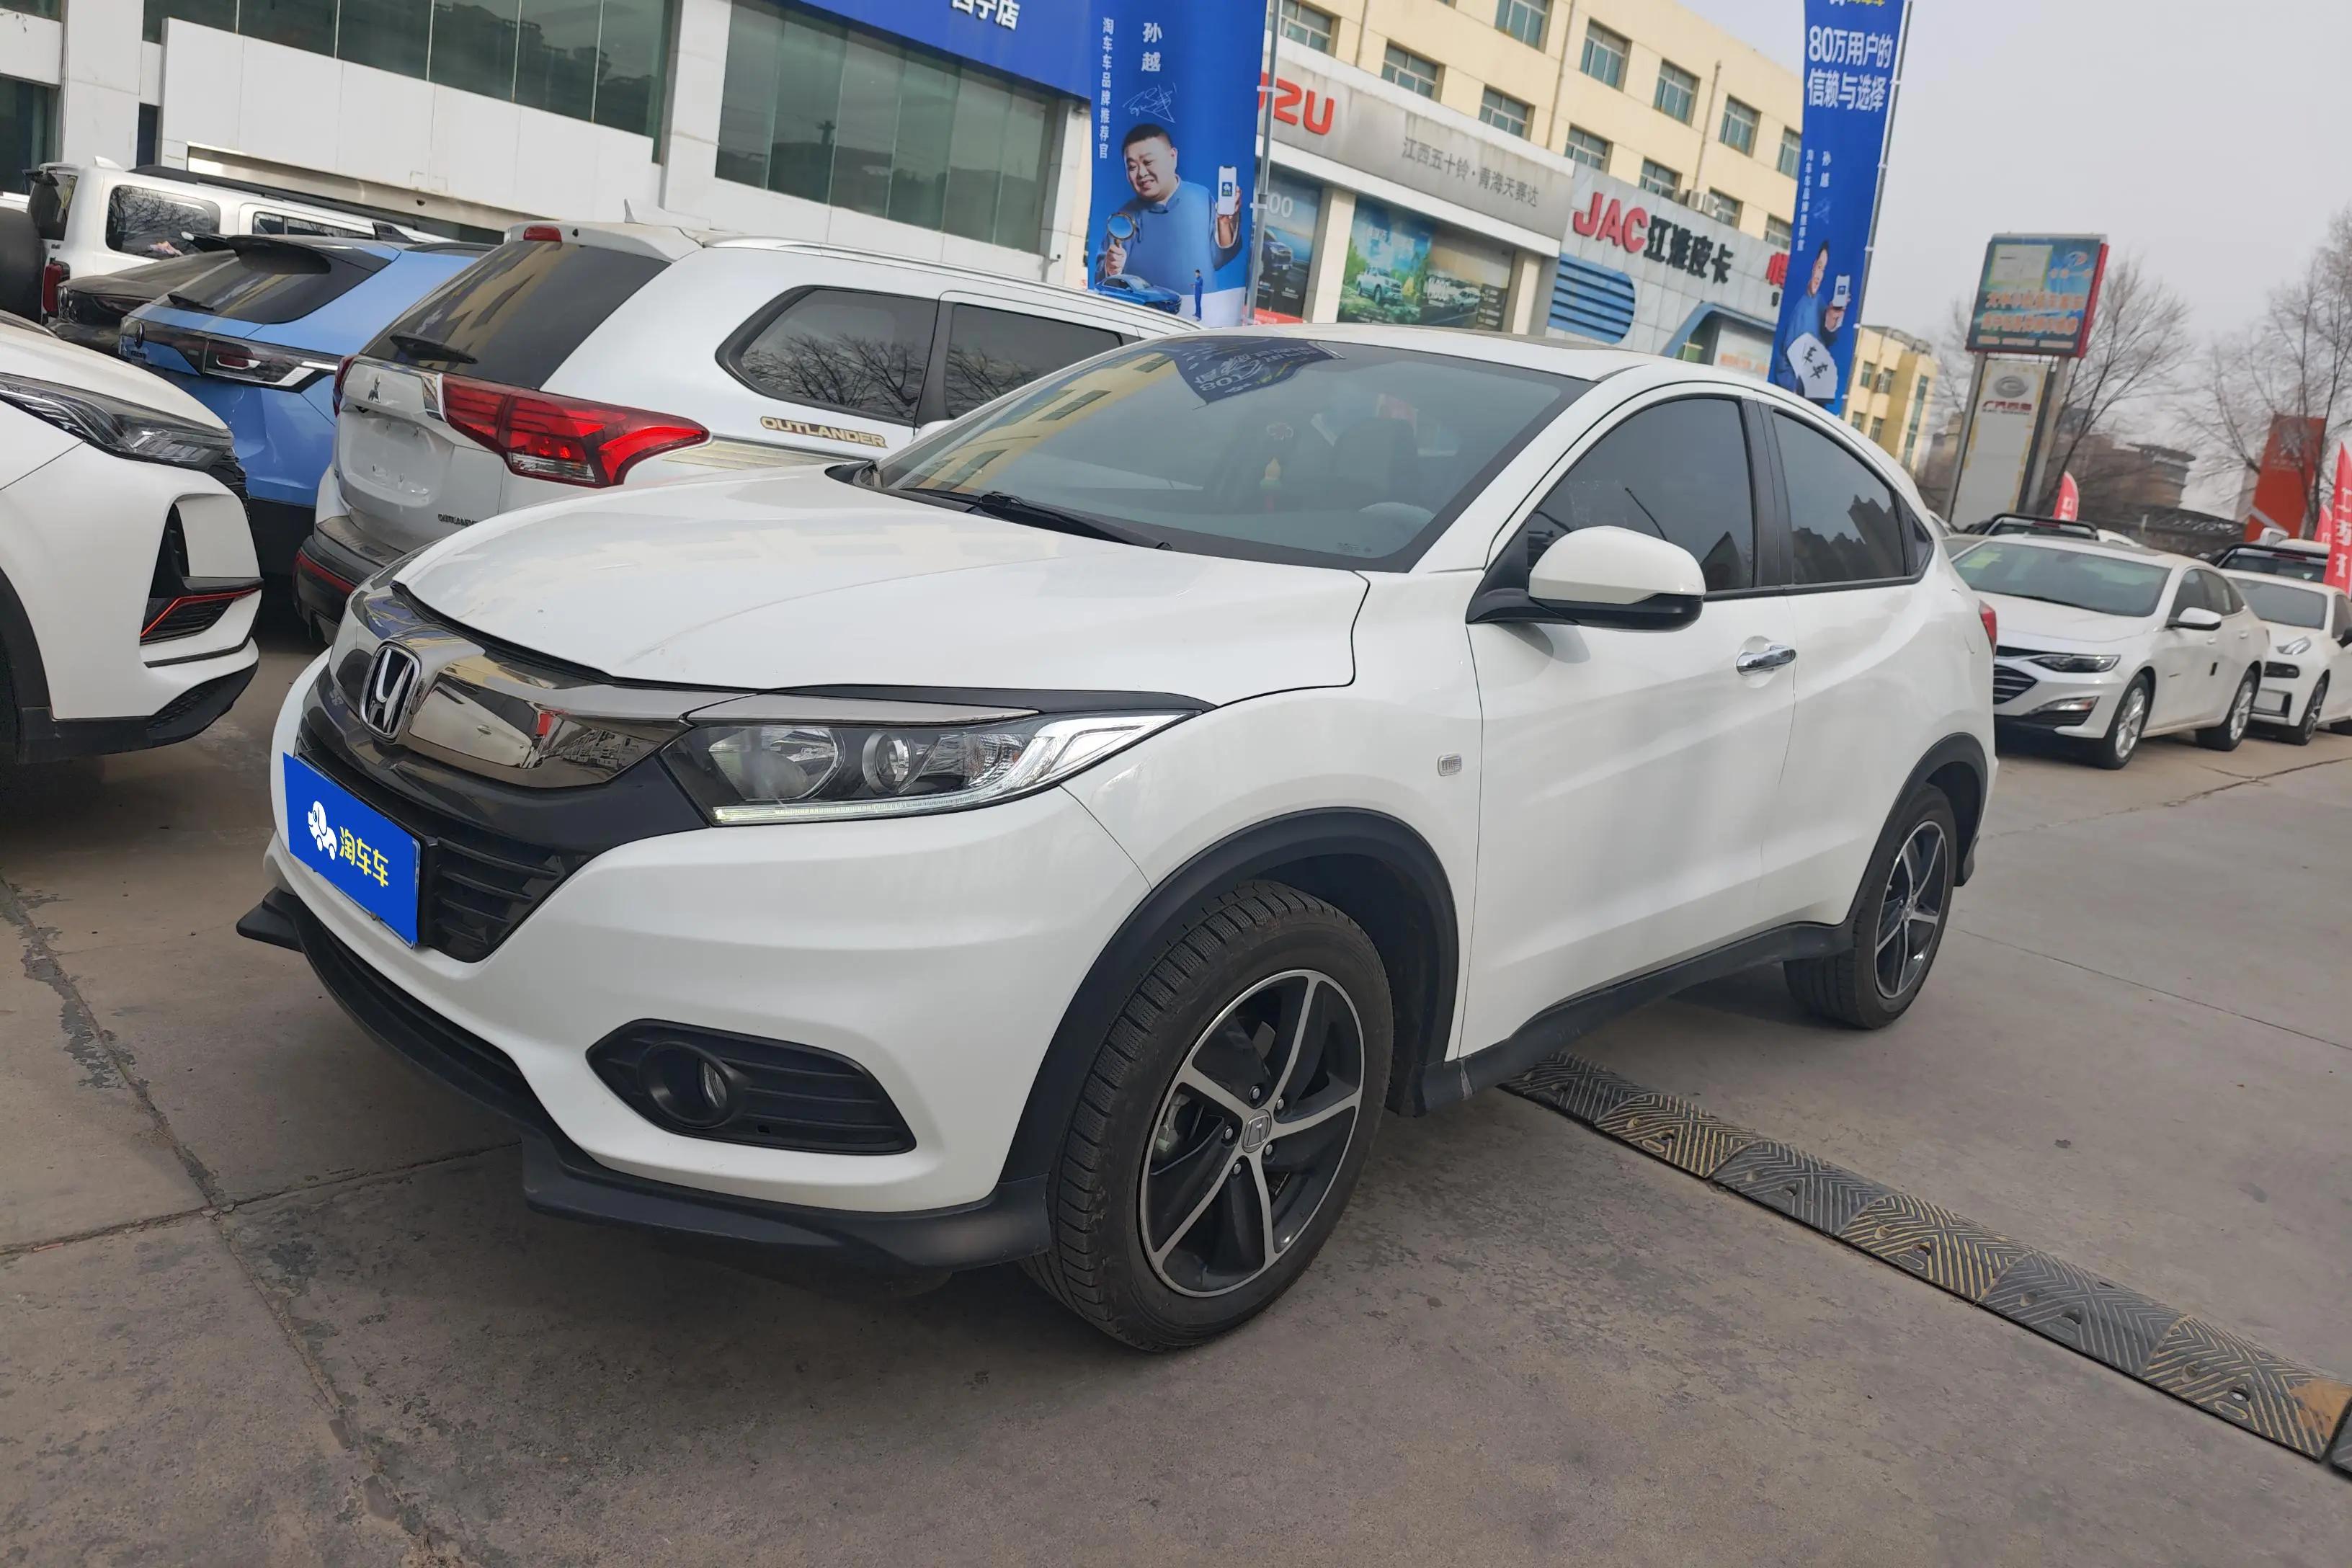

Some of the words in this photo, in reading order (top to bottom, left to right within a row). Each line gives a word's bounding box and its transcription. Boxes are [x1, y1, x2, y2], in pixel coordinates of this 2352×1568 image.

[1141, 22, 1162, 72] 孙越
[1808, 25, 1893, 68] 80万用户的
[1100, 17, 1114, 159] 淘车车品牌推荐官
[1807, 67, 1886, 112] 信赖与选择
[1573, 192, 1648, 253] JAC
[761, 416, 888, 448] OUTLANDER
